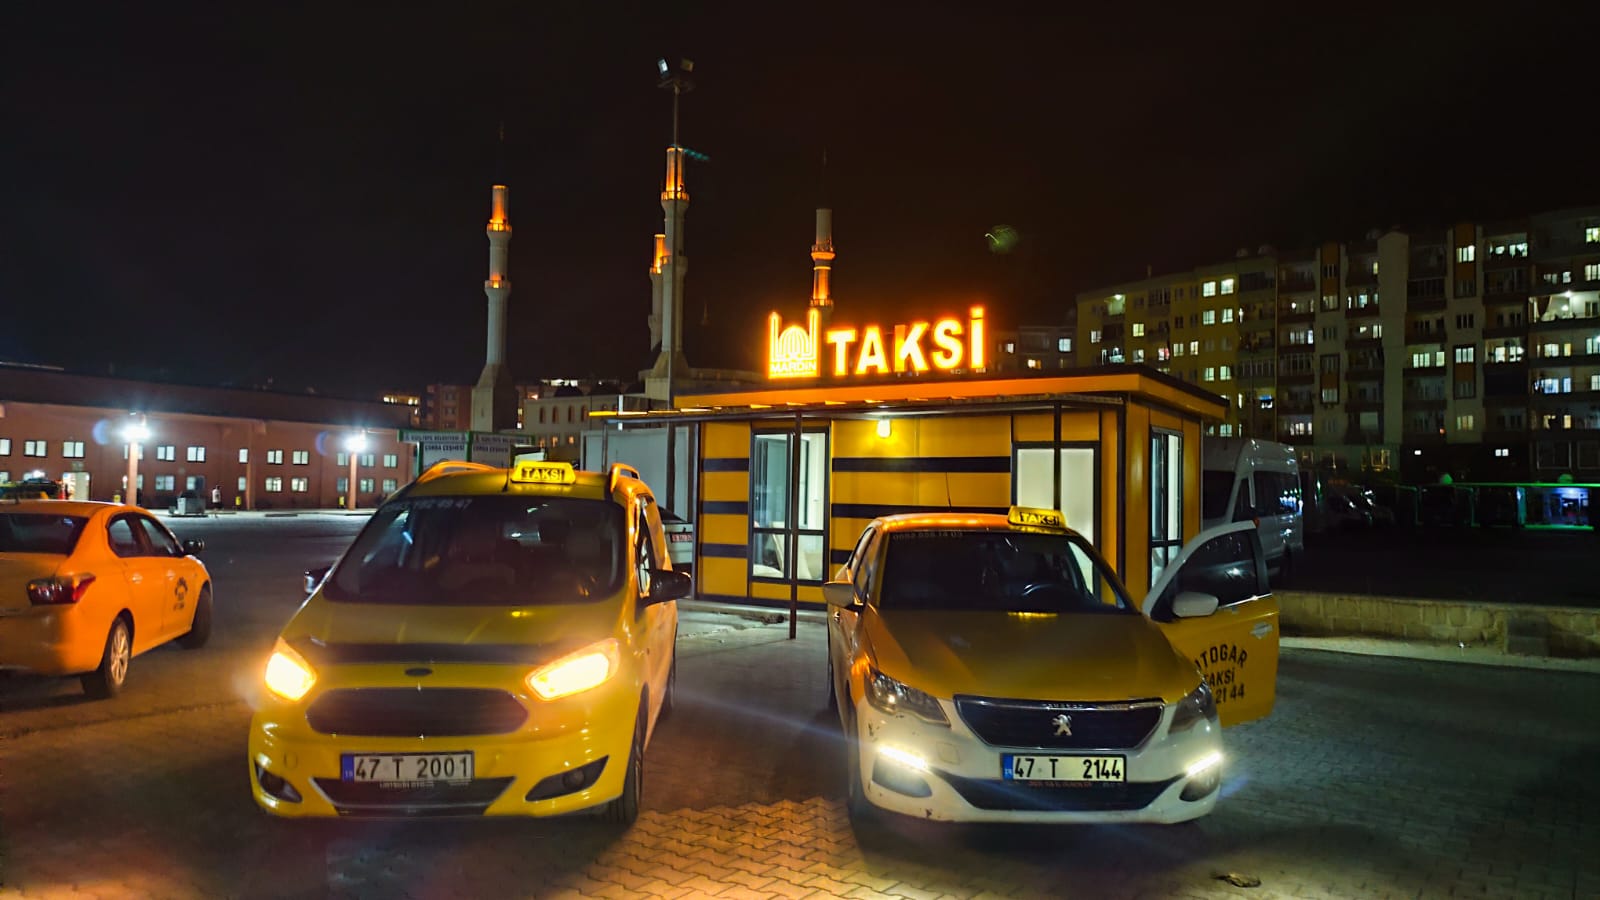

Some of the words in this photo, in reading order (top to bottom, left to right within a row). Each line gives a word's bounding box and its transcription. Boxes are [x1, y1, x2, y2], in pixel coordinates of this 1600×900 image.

[826, 306, 985, 376] TAKSİ
[356, 758, 381, 779] 47
[392, 758, 404, 779] T
[417, 757, 468, 779] 2001
[1015, 757, 1035, 778] 47
[1049, 758, 1059, 778] T
[1082, 758, 1121, 779] 2144
